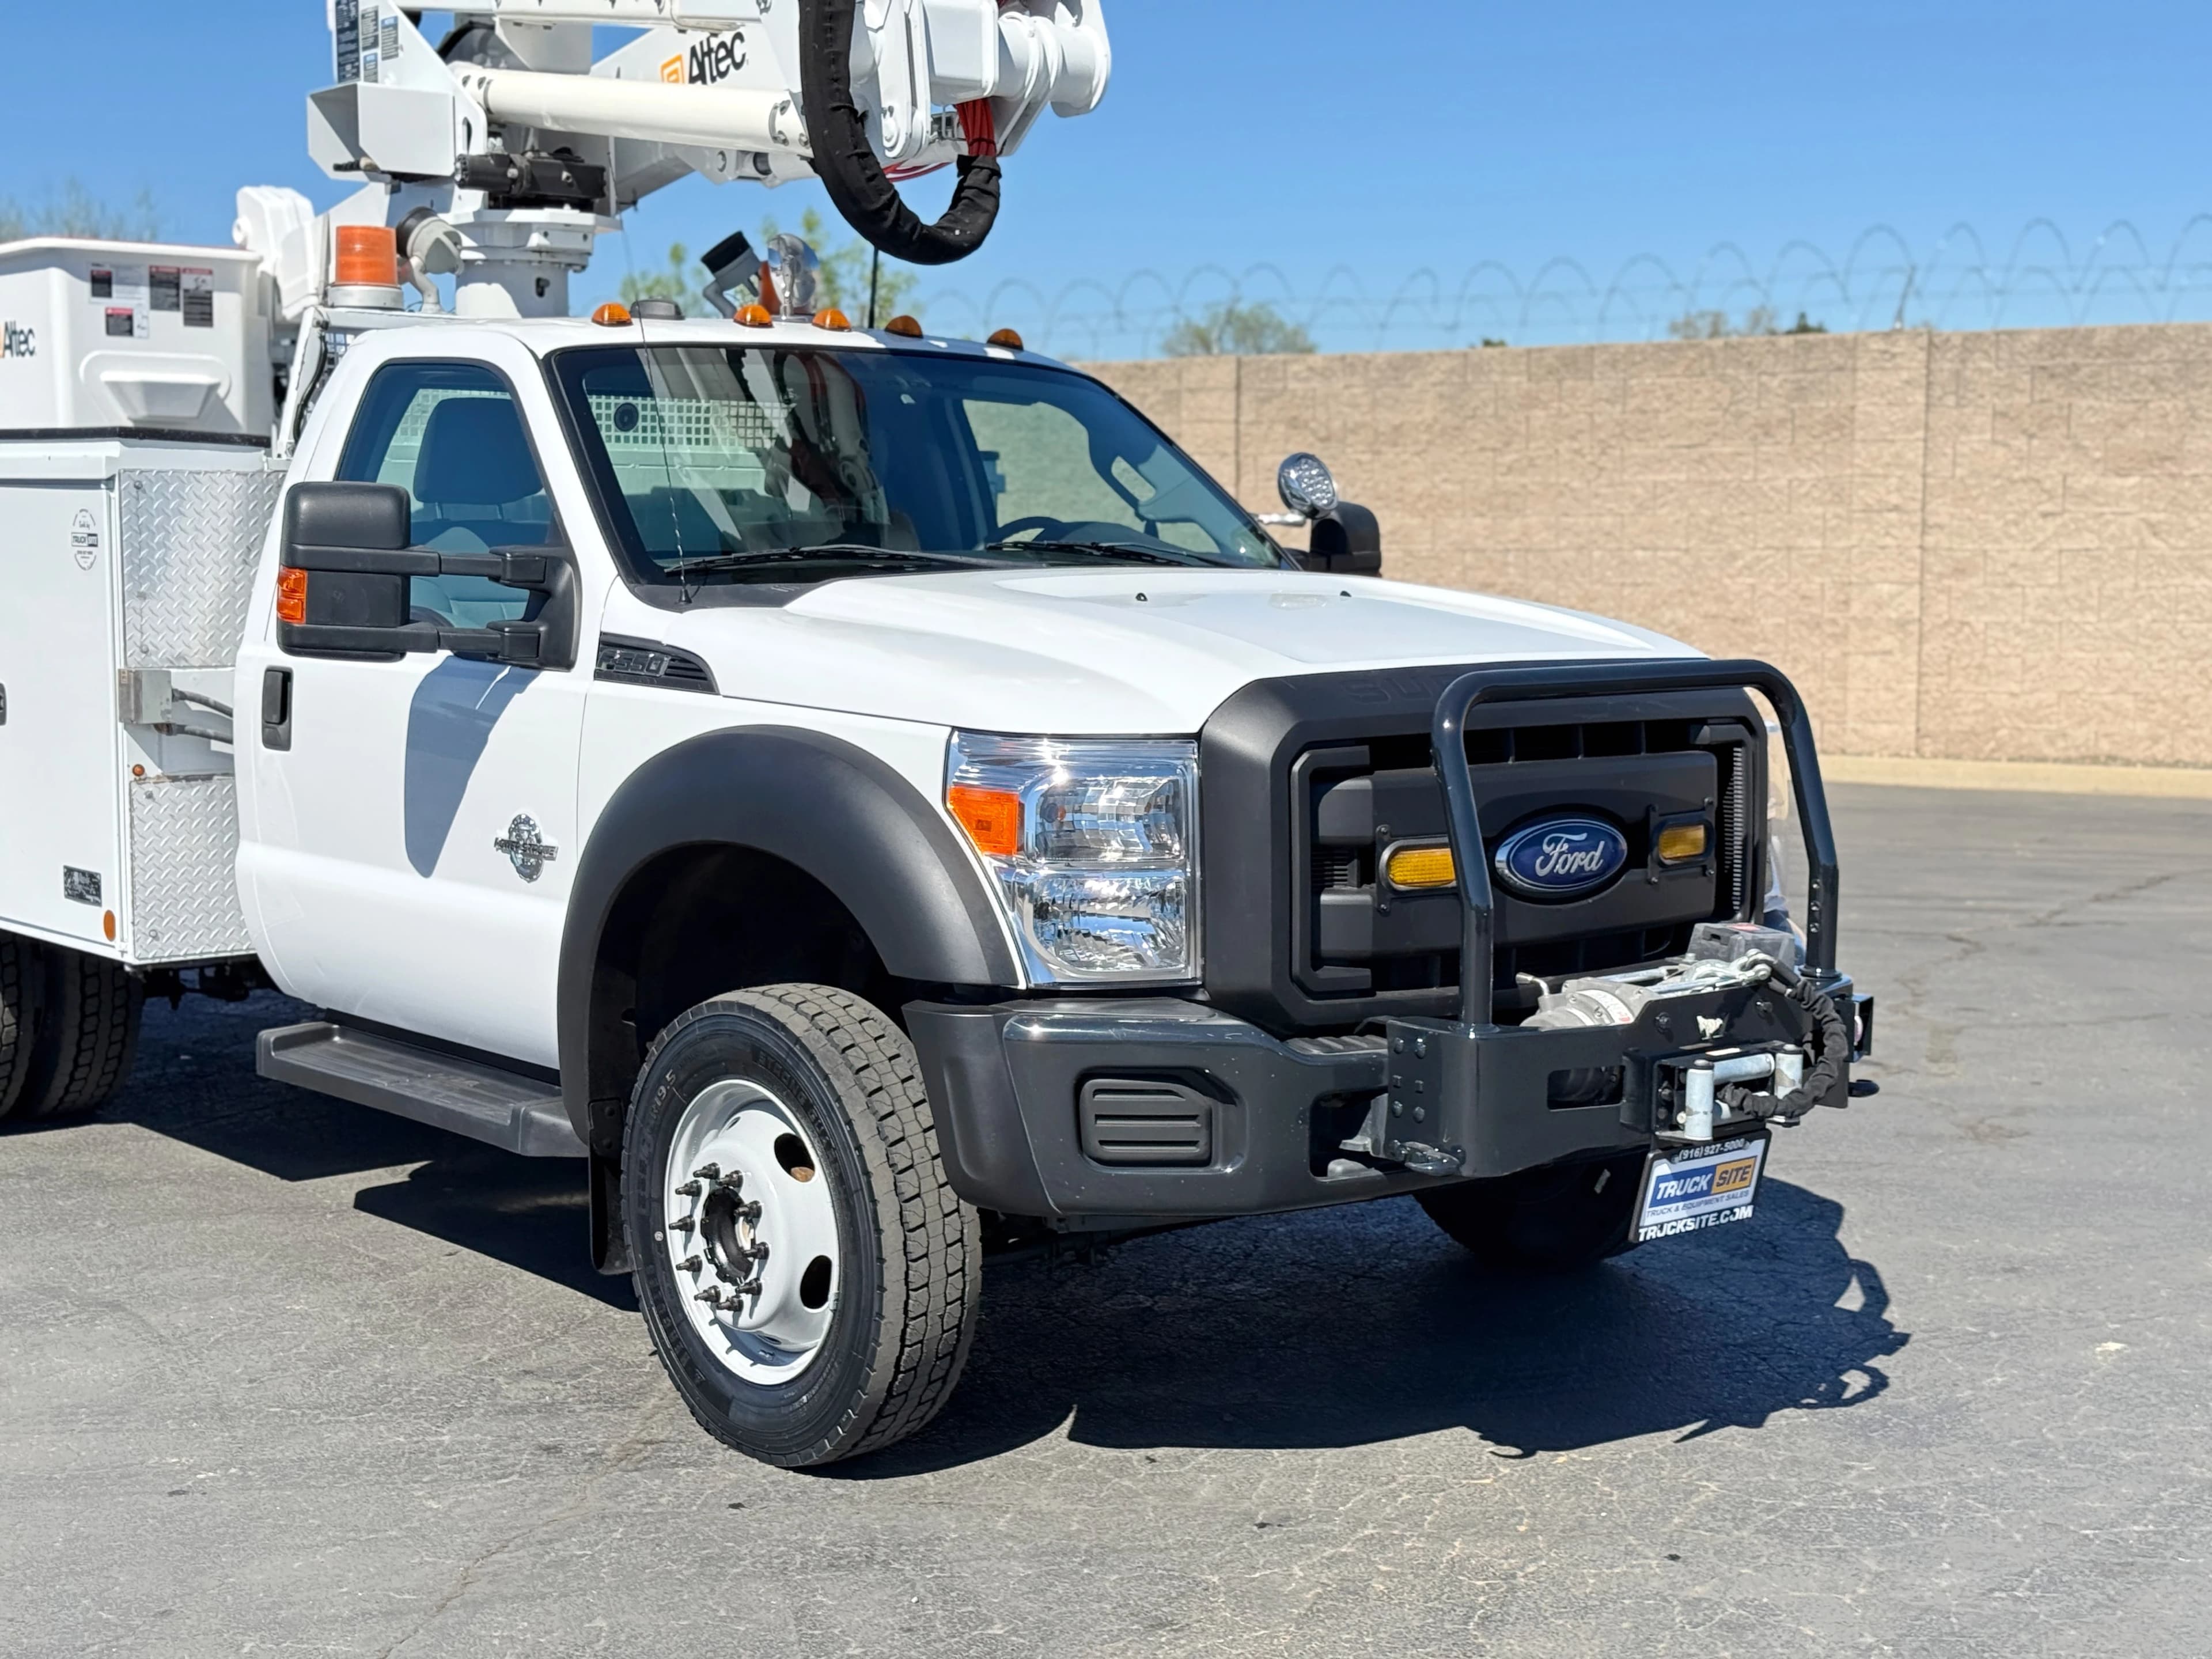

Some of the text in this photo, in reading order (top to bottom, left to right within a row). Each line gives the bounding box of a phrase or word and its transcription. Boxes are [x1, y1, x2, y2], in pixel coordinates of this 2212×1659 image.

[689, 32, 747, 85] Altec
[3, 320, 36, 358] Altec
[1535, 833, 1605, 877] Ford
[1656, 1164, 1752, 1200] TRUCK SITE
[1646, 1206, 1673, 1218] TRUCK
[1681, 1196, 1724, 1210] EQUIPMENT
[1725, 1190, 1749, 1201] SALES
